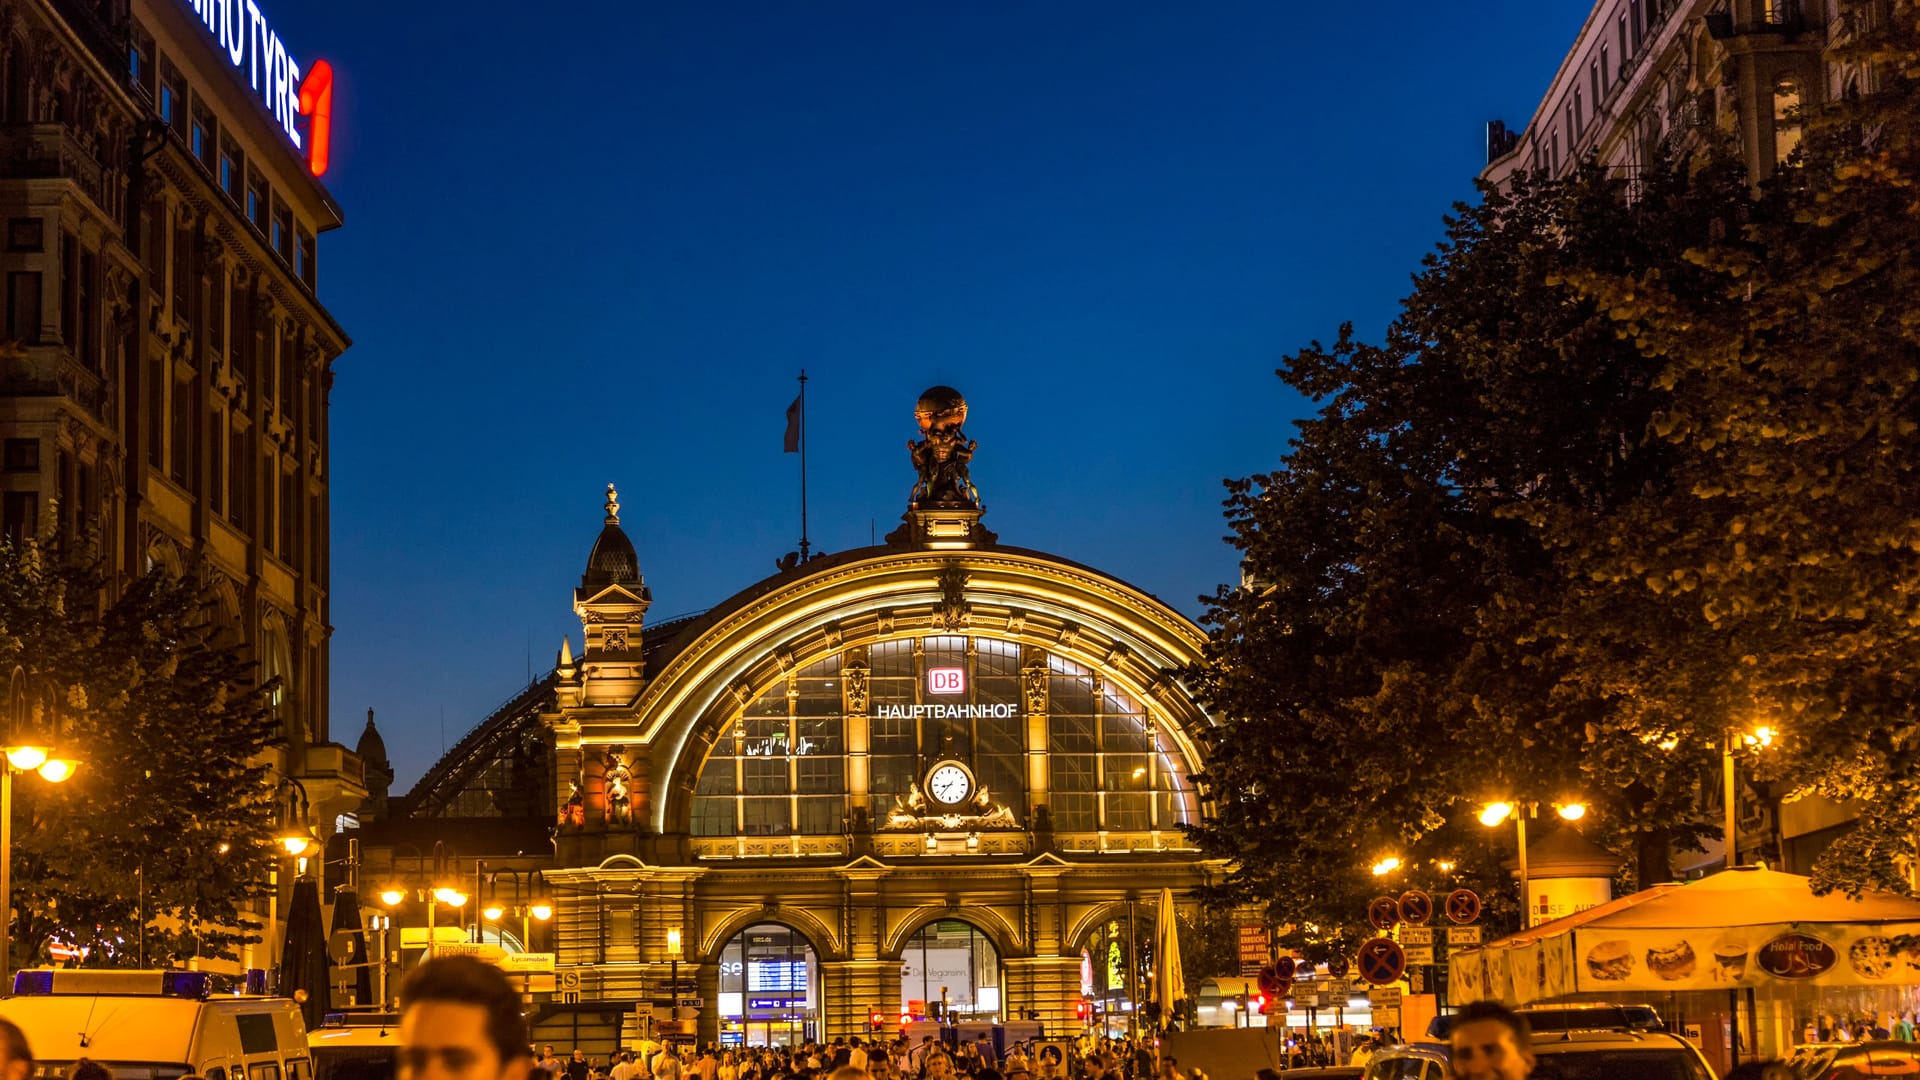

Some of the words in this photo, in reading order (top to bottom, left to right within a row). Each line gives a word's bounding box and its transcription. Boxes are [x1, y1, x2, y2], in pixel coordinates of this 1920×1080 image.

[247, 0, 301, 149] TYRE
[934, 672, 960, 689] DB
[877, 703, 1018, 719] HAUPTBAHNHOF
[1770, 942, 1795, 951] Halal
[1799, 942, 1824, 952] Food
[566, 974, 577, 986] S
